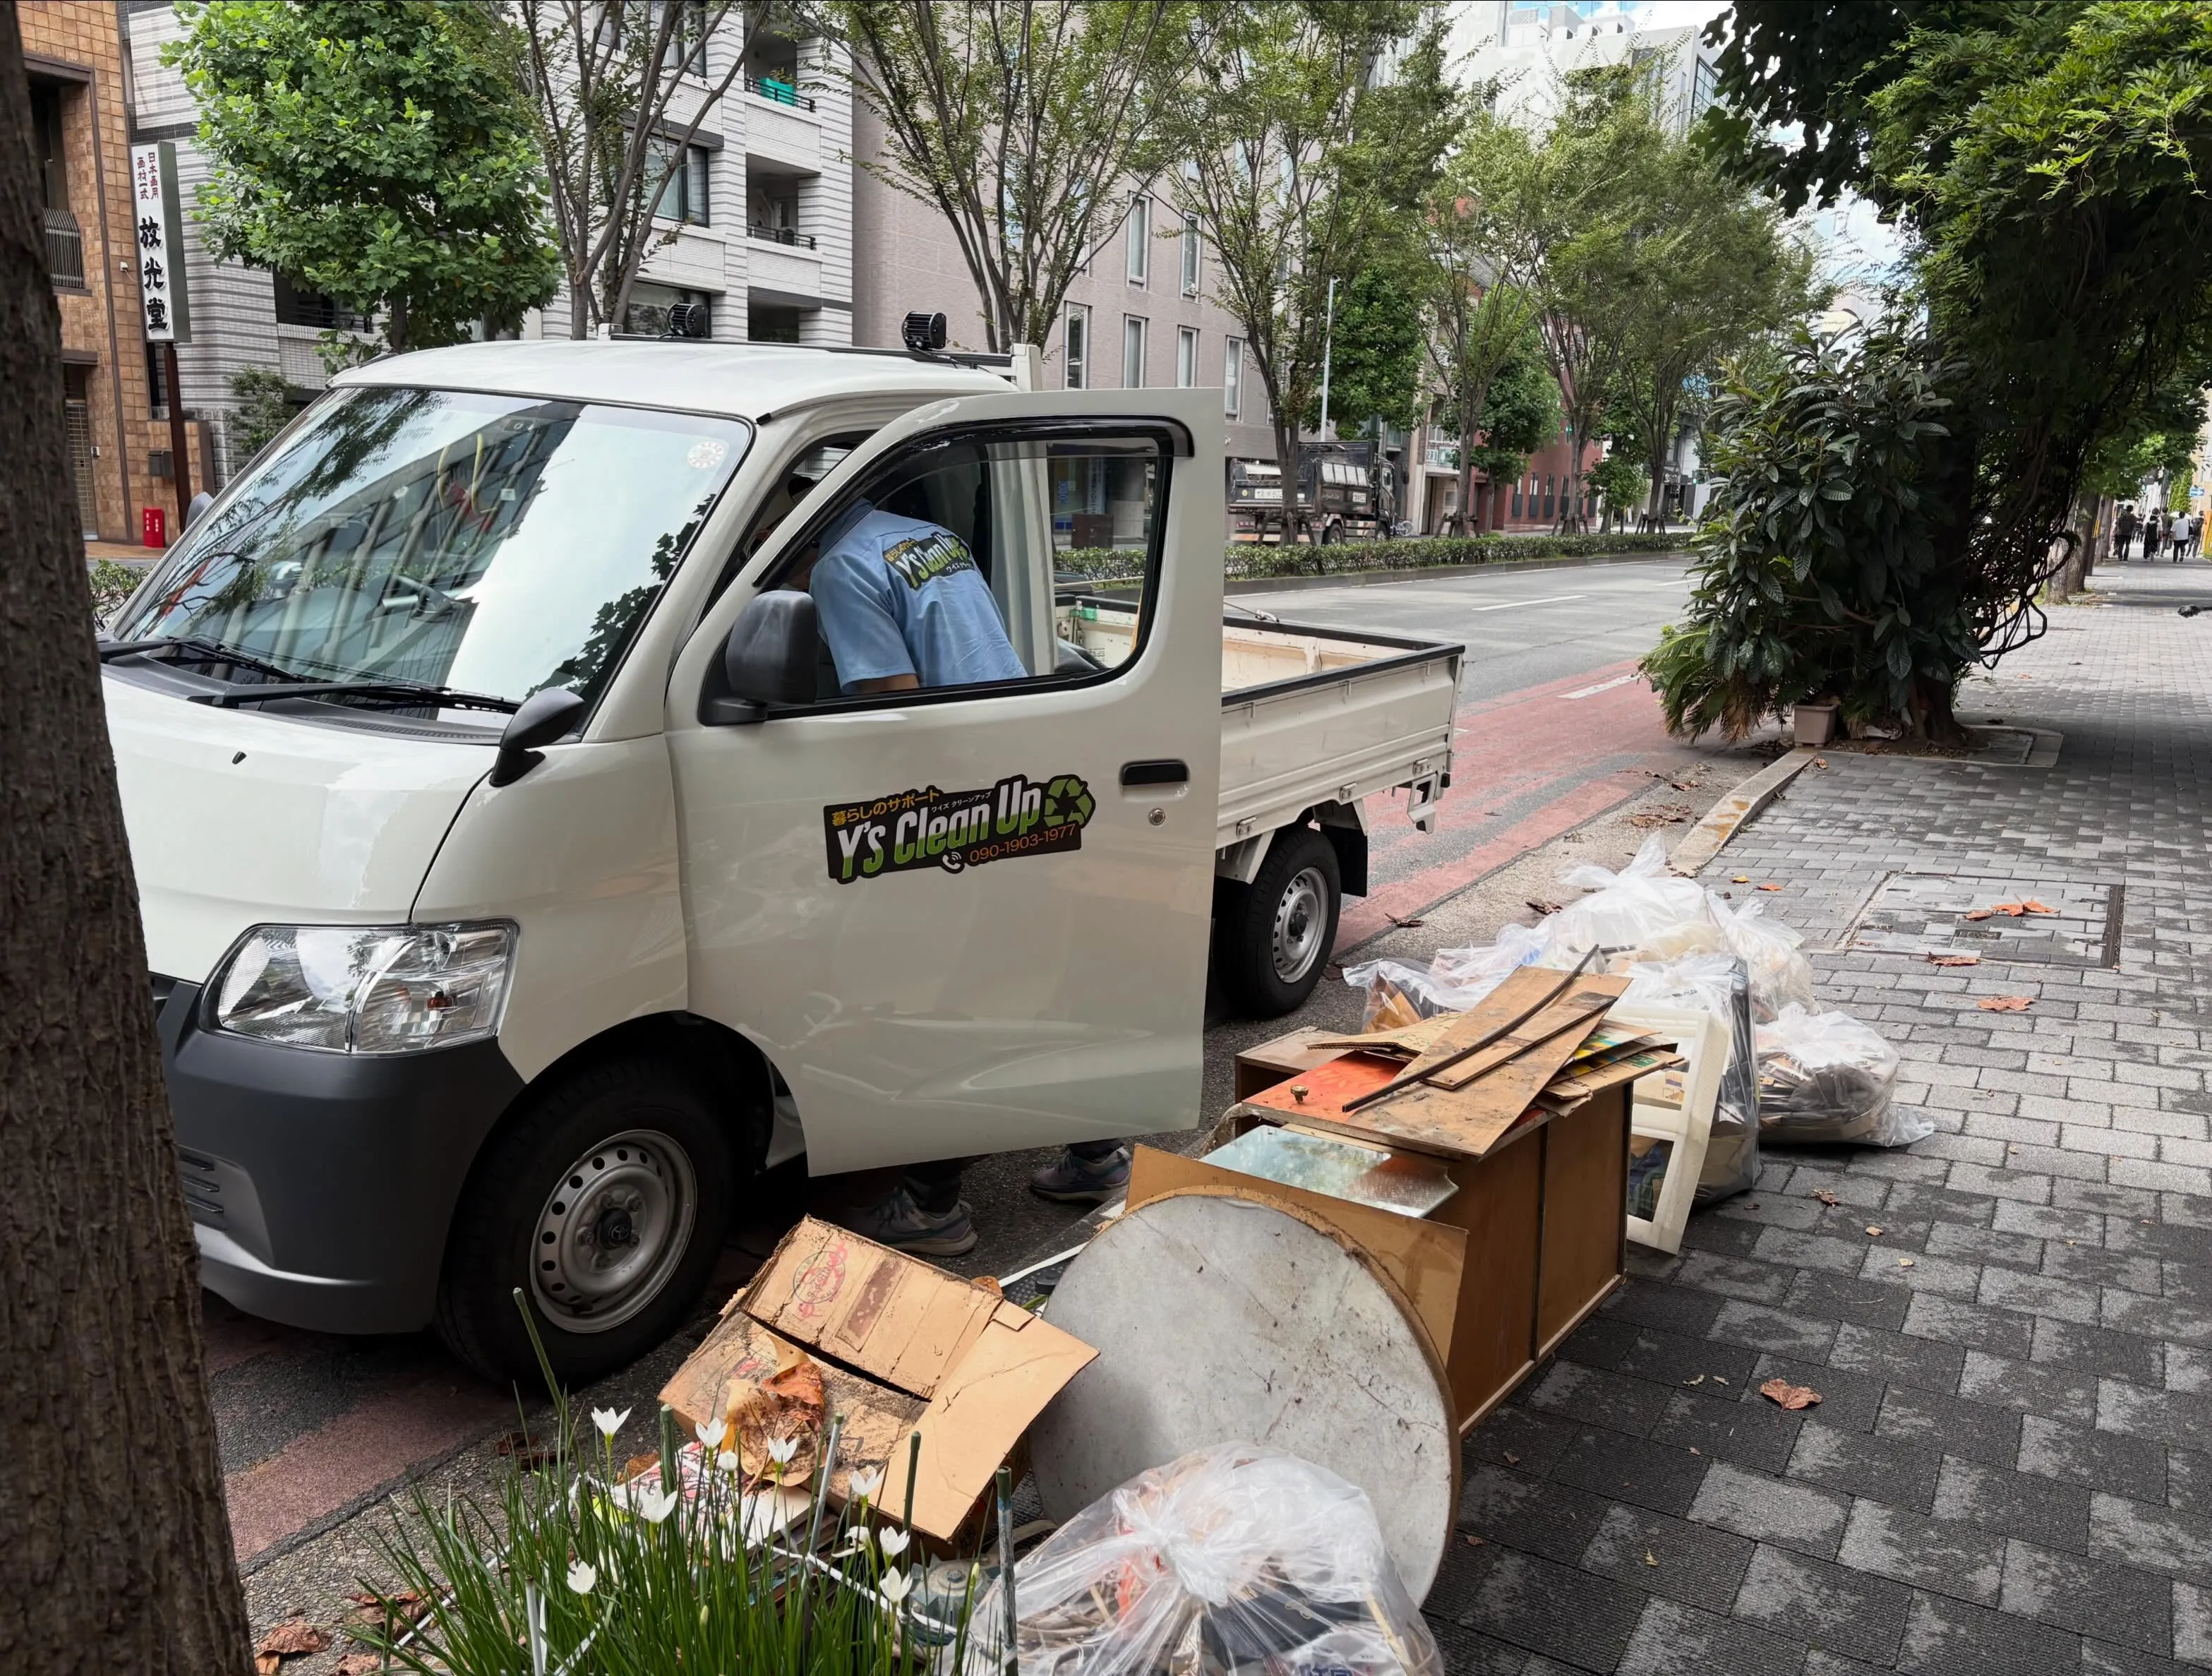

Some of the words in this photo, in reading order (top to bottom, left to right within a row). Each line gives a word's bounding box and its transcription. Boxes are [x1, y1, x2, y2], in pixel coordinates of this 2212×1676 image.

[148, 152, 159, 200] 日本画用
[138, 215, 168, 330] 放光堂
[831, 789, 940, 827] 暮らしのサポート
[837, 820, 886, 879] Y's
[894, 802, 991, 865] Clean
[997, 779, 1042, 835] Up
[969, 823, 1076, 863] 090-1903-1977
